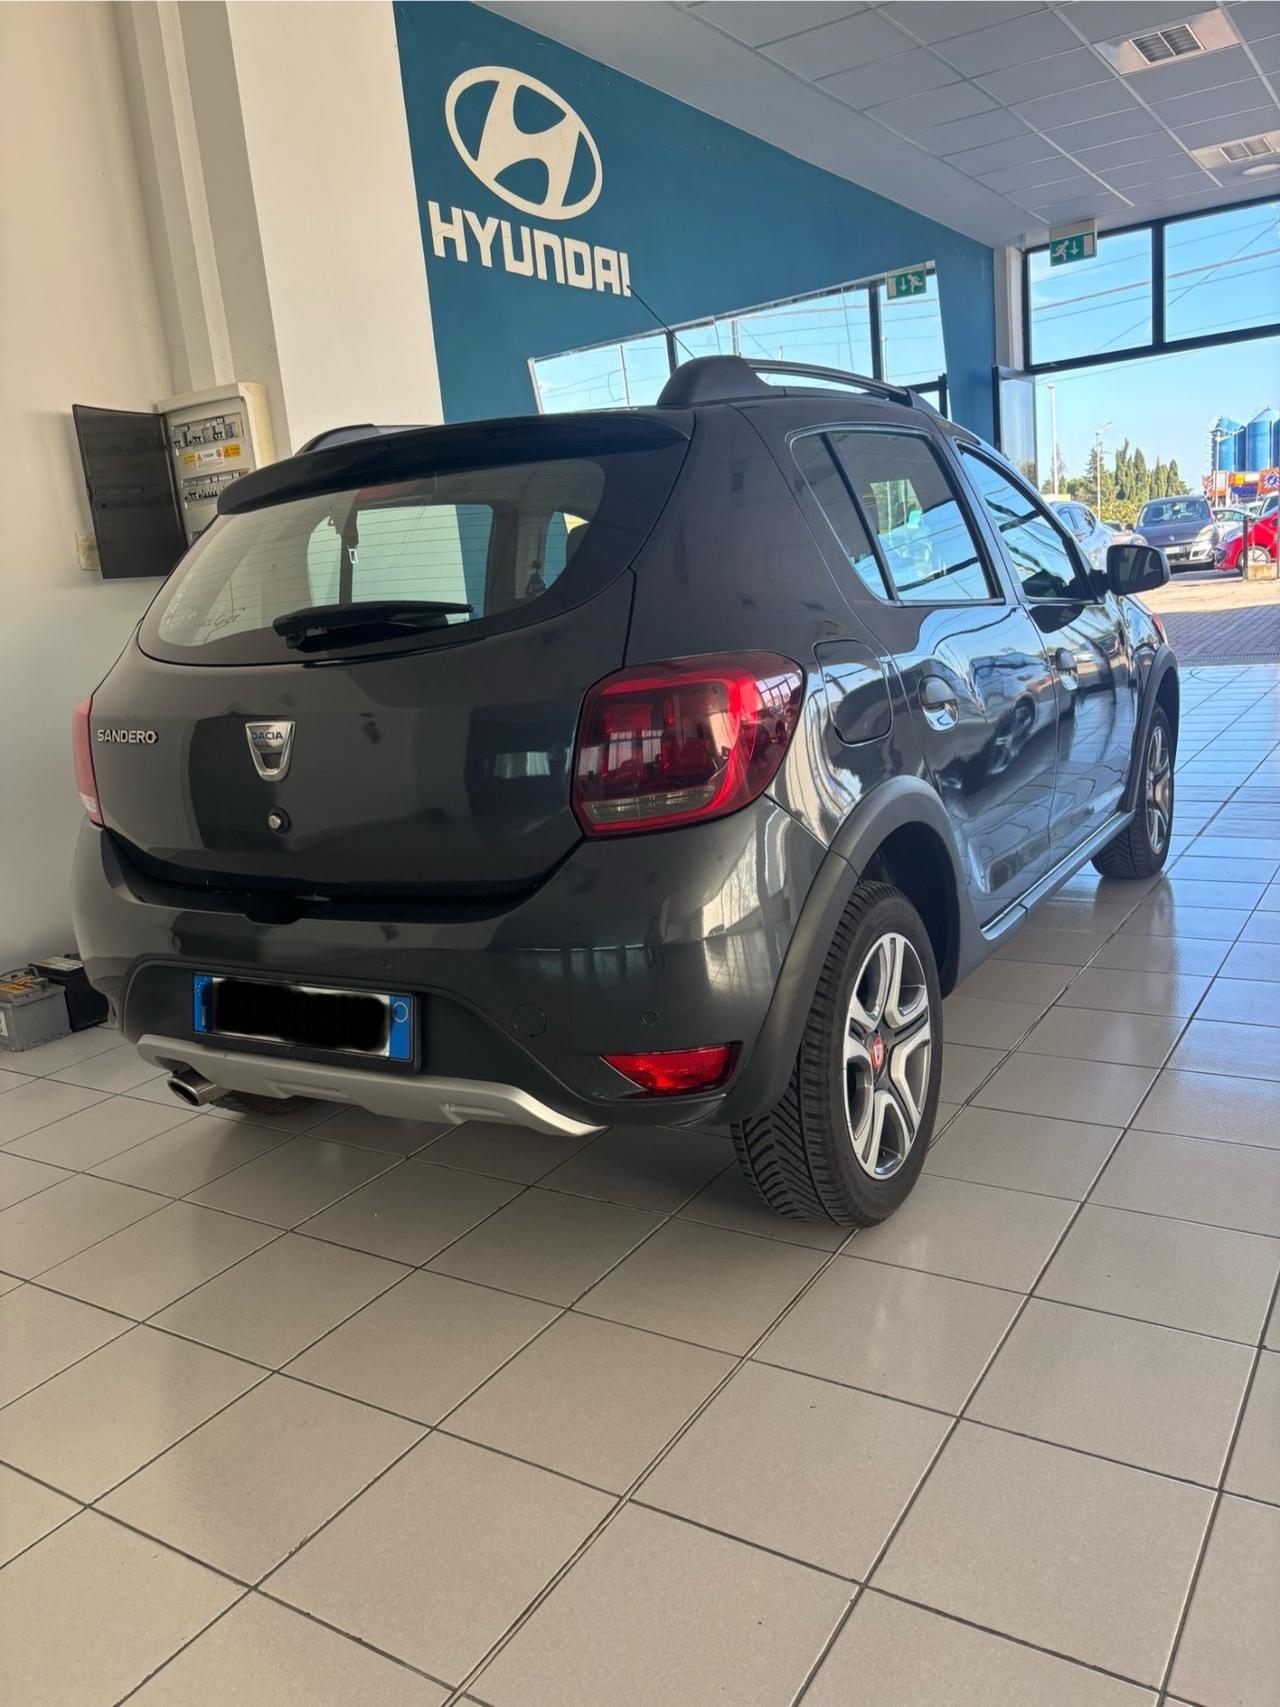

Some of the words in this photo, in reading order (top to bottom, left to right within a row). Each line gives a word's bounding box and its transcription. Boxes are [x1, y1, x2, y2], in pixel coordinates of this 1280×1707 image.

[428, 200, 632, 297] HYUNDAI
[97, 729, 157, 744] SANDERO
[252, 731, 284, 740] DACIA
